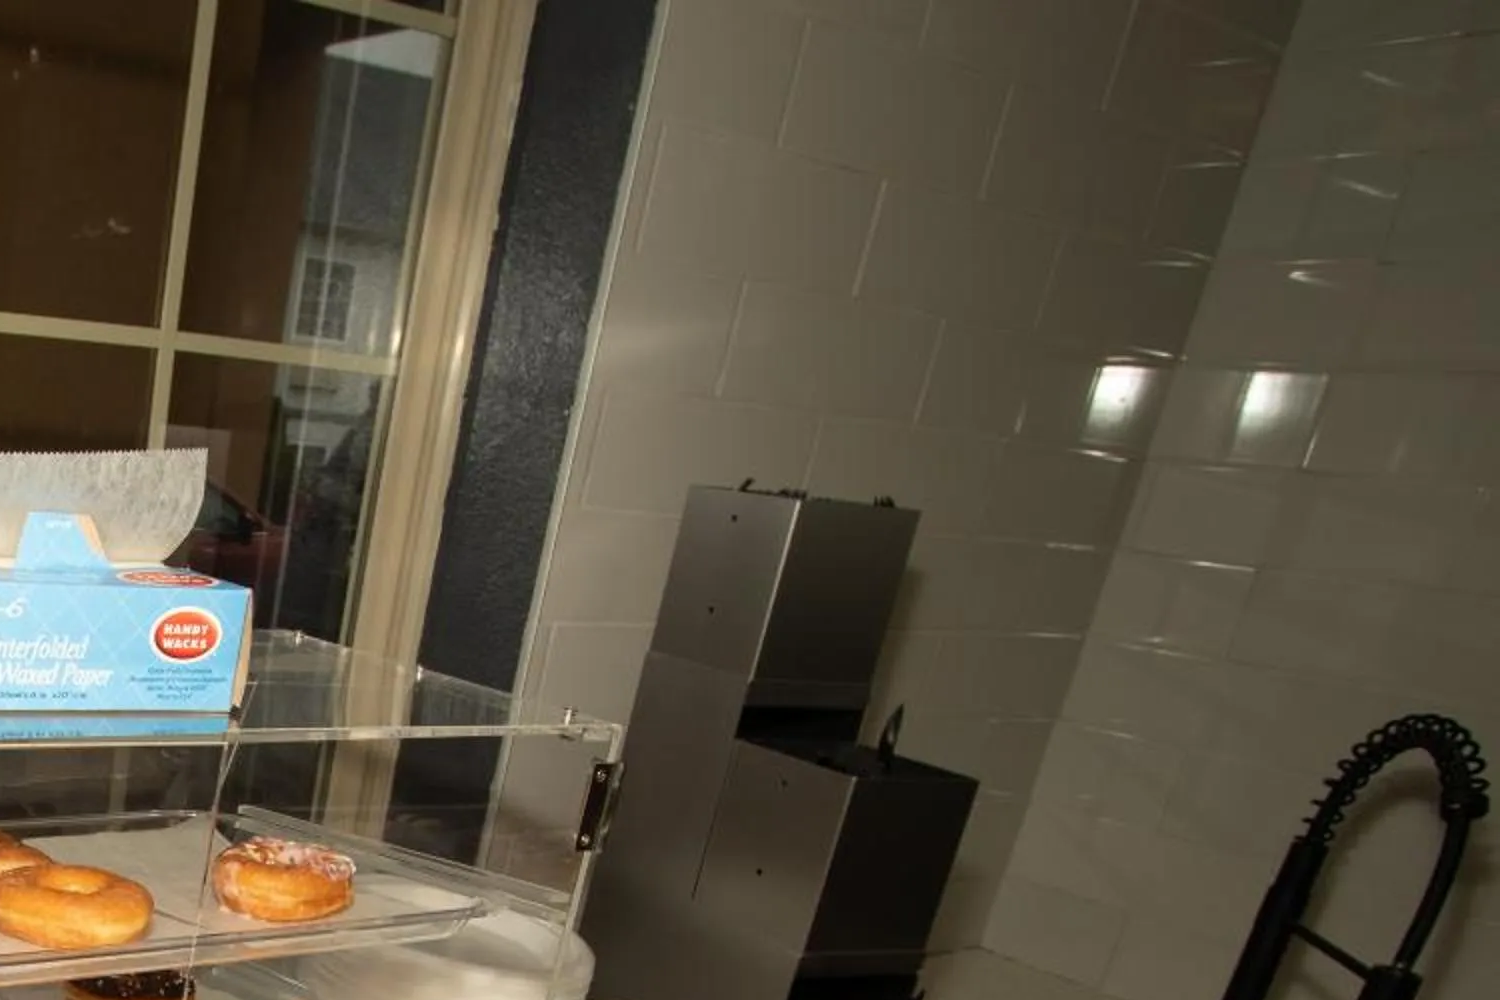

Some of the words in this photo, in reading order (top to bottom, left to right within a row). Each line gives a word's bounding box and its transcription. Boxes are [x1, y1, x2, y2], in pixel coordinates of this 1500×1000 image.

[163, 623, 209, 635] HANDY
[163, 639, 207, 649] WACKS
[61, 662, 115, 691] Paper
